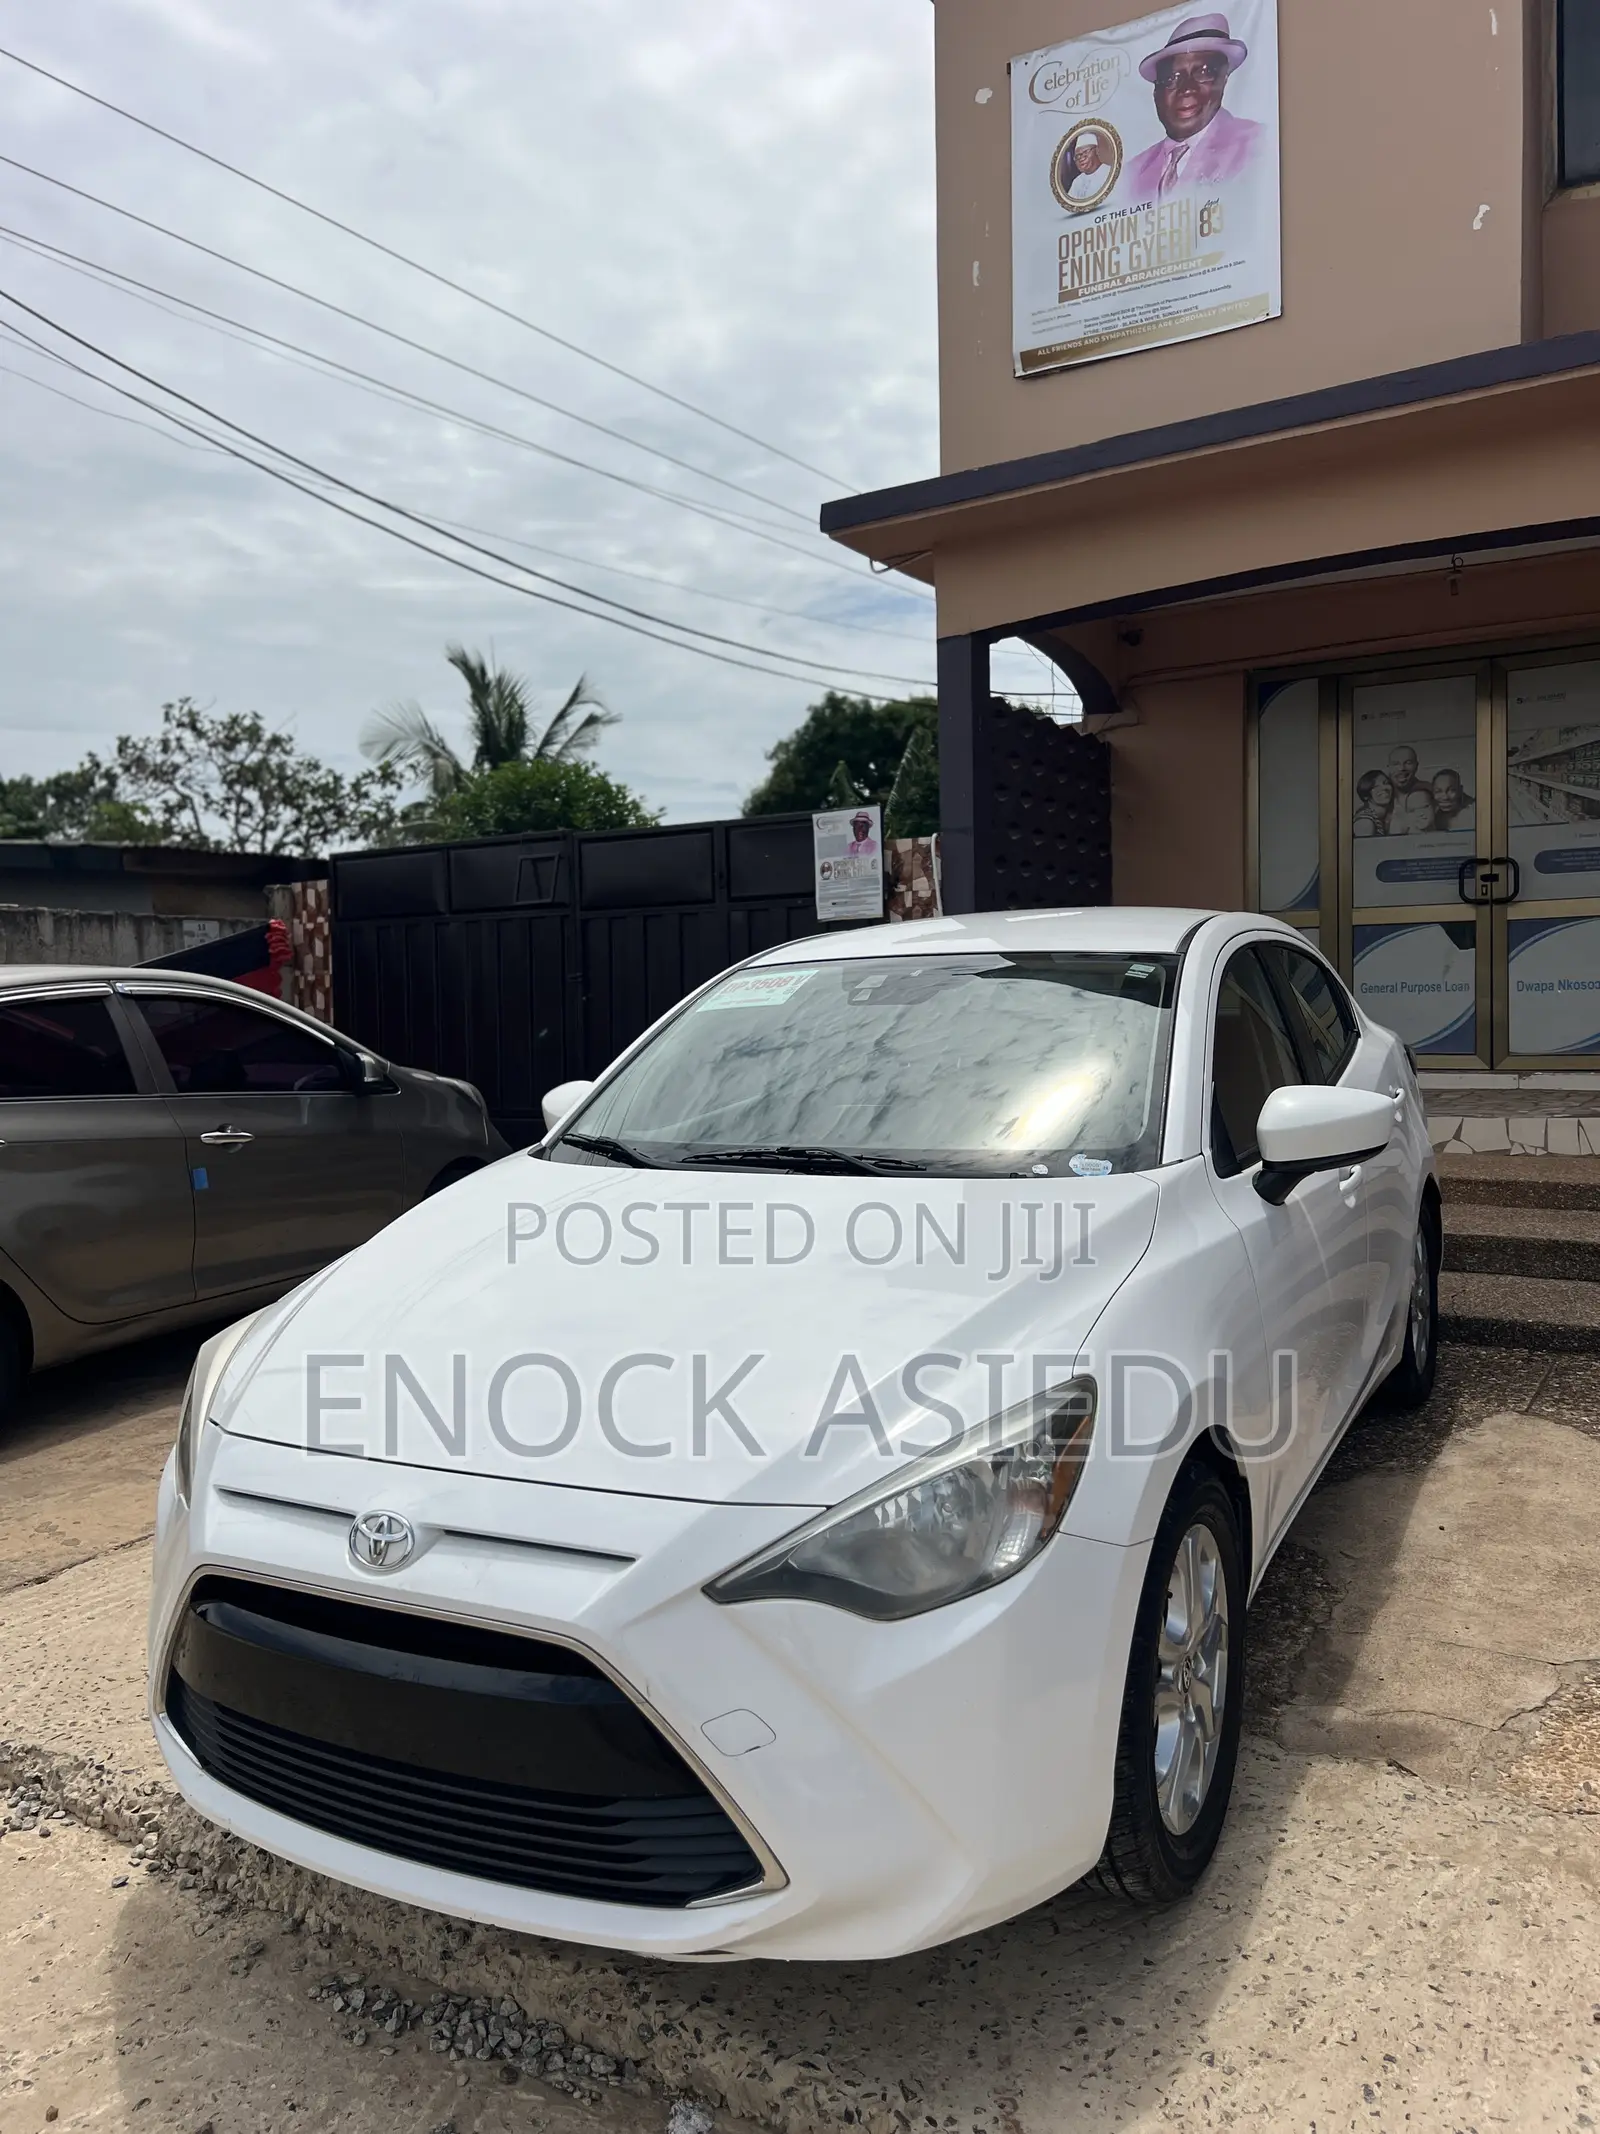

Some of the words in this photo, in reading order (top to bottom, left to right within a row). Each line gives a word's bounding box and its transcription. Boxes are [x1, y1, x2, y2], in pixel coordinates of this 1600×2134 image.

[1029, 54, 1120, 104] Celebration
[1065, 90, 1082, 108] of
[1082, 76, 1109, 107] Life
[1058, 215, 1138, 260] OPANYIN
[1144, 198, 1191, 236] SETH
[1094, 214, 1108, 225] OF
[1110, 209, 1128, 220] THE
[1130, 201, 1153, 215] LATE
[1200, 203, 1224, 237] 83
[1058, 245, 1120, 291] ENING
[1078, 279, 1122, 297] FUNERAL
[1124, 258, 1203, 284] ARRANGEMENT
[1037, 348, 1051, 356] ALL
[1051, 340, 1082, 352] FRIENDS
[1084, 337, 1100, 346] AND
[1102, 325, 1157, 342] SYMPATHIZERS
[1158, 319, 1173, 329] ARE
[1174, 308, 1218, 325] CORDIALLY
[1218, 301, 1250, 313] INVITED
[1360, 981, 1398, 994] General
[1401, 981, 1442, 994] Purpose
[1445, 981, 1470, 993] Loan
[1516, 980, 1555, 994] Dwapa
